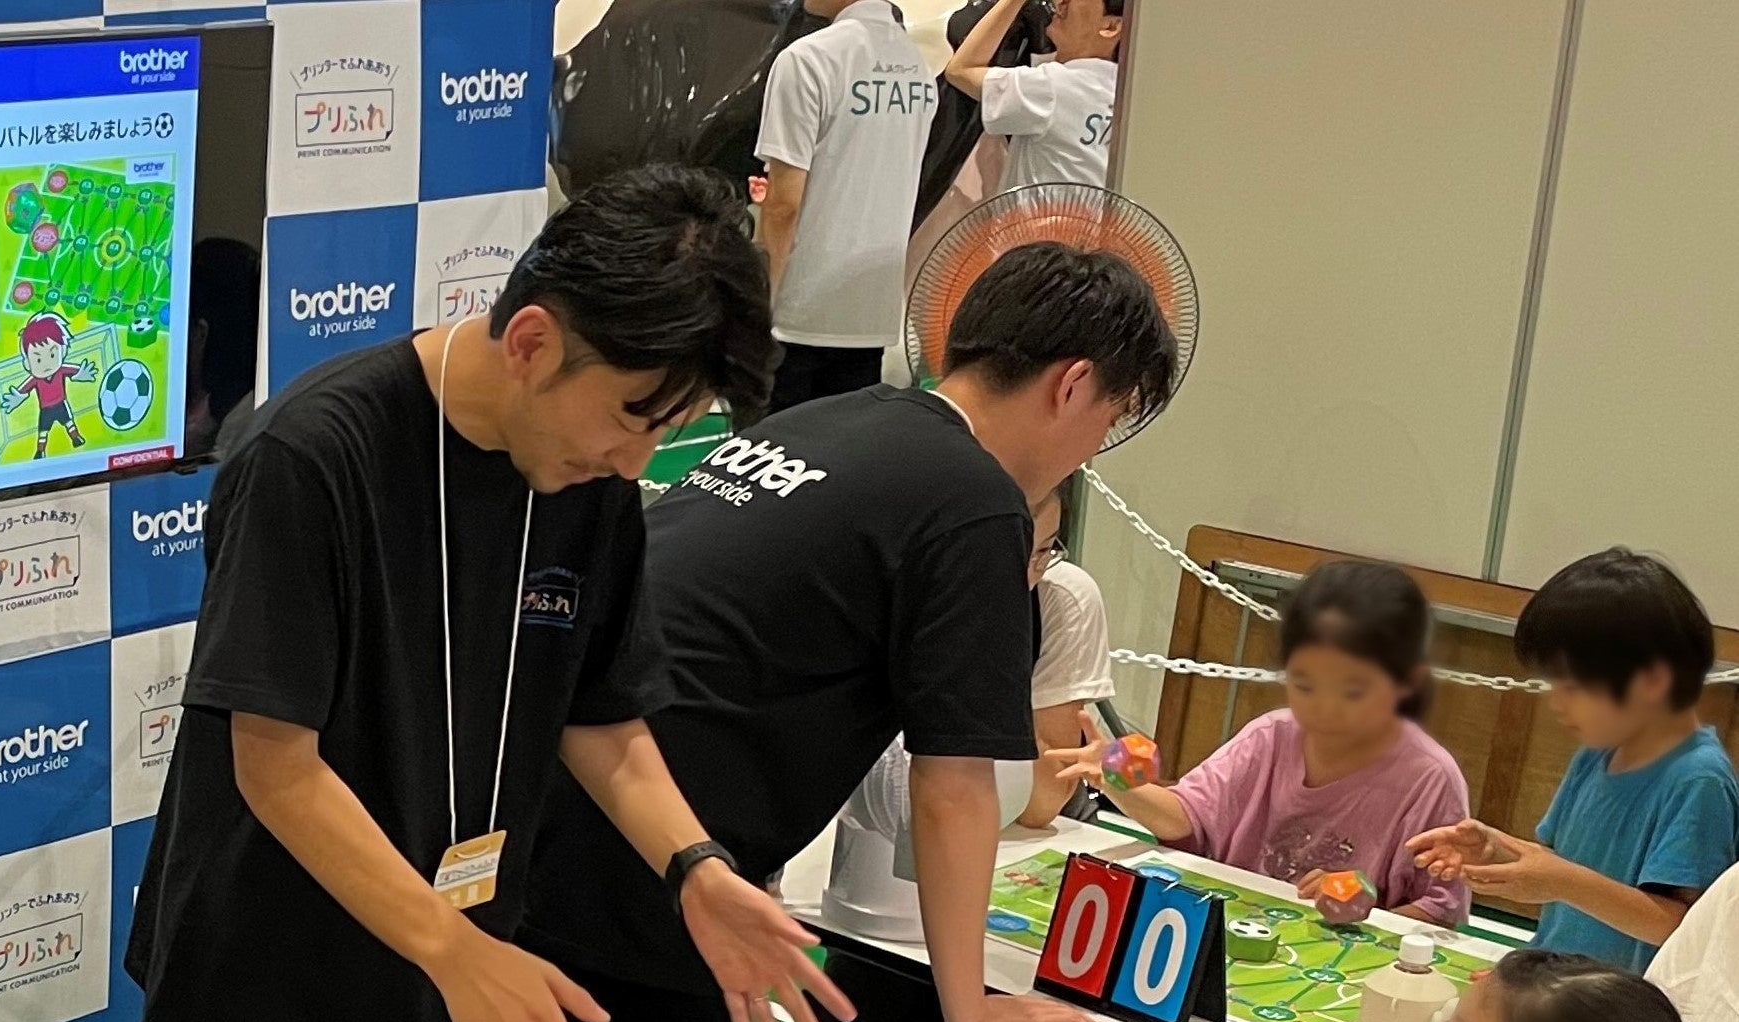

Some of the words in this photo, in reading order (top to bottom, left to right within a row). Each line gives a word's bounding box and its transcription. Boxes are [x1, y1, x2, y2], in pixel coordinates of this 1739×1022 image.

[119, 48, 189, 74] brother
[441, 69, 527, 105] brother
[851, 80, 935, 115] STAFF
[304, 102, 384, 133] プリふれ
[457, 109, 466, 121] at
[469, 108, 492, 124] your
[493, 104, 512, 118] side
[134, 162, 164, 173] brother
[291, 282, 395, 320] brother
[309, 323, 321, 336] at
[324, 321, 351, 338] your
[353, 316, 376, 331] side
[112, 450, 169, 468] CONFIDENTIAL
[714, 481, 753, 506] side
[152, 543, 165, 556] at
[169, 538, 197, 556] your
[11, 763, 41, 783] your
[43, 755, 68, 772] side
[1058, 883, 1111, 979] 0
[1134, 907, 1188, 1006] 0
